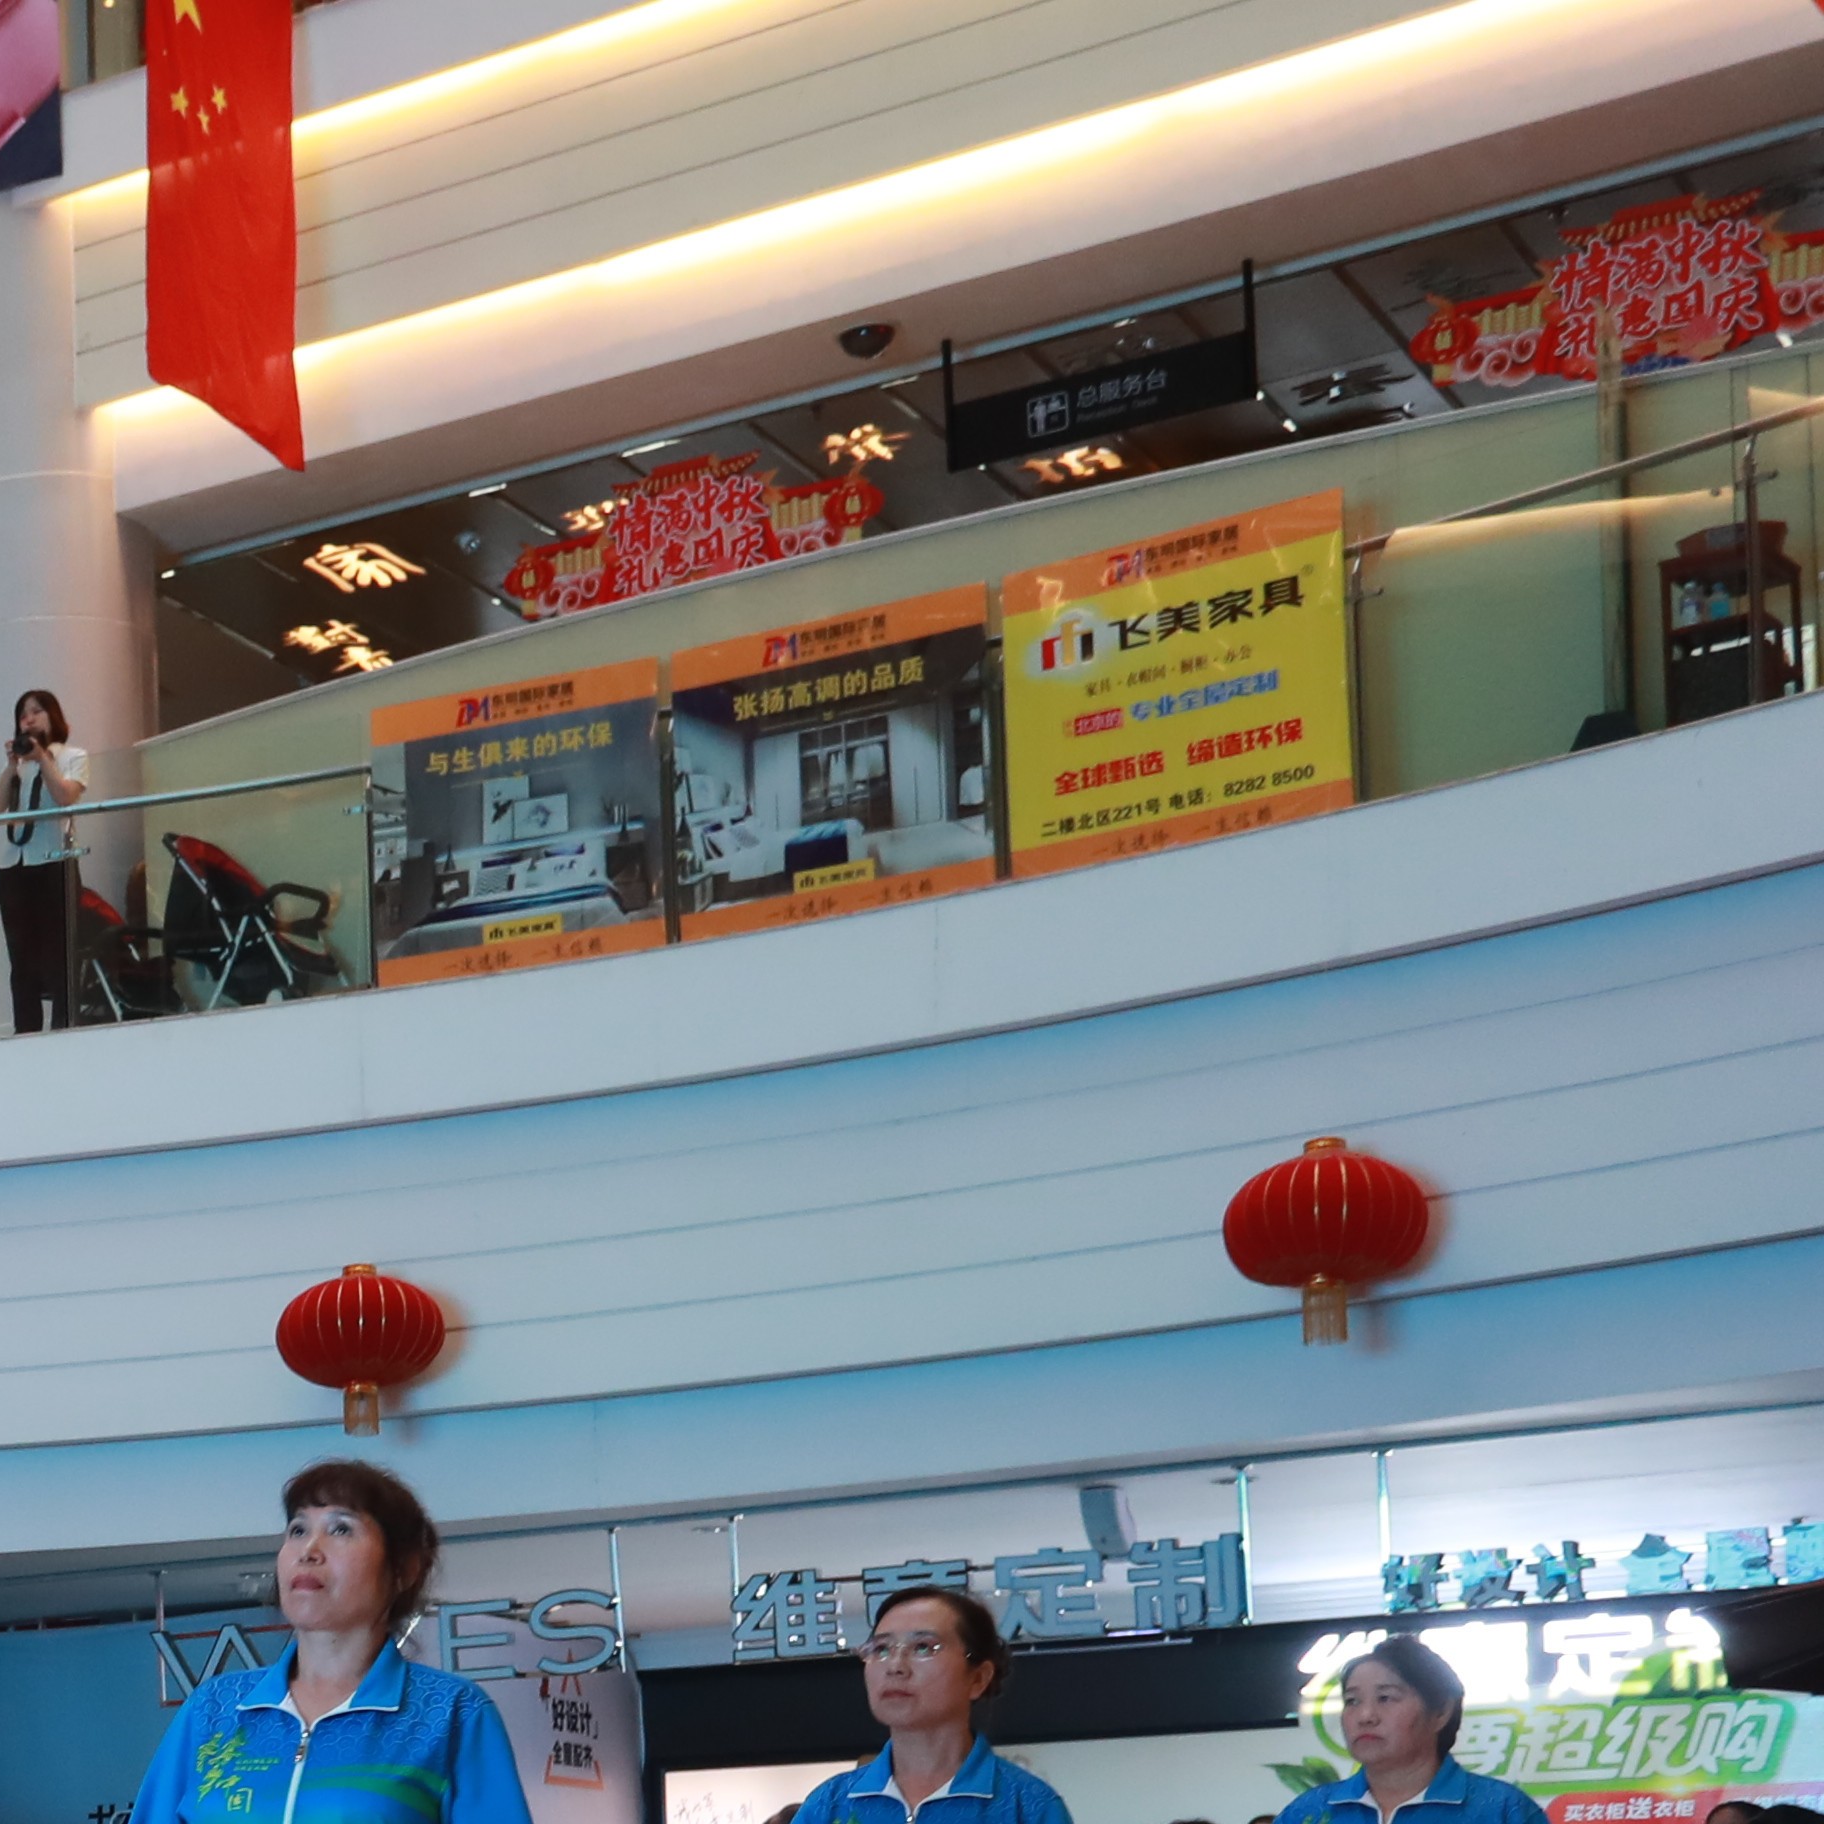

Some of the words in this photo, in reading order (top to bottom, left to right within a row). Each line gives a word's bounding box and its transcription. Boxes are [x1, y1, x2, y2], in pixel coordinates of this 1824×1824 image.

[1552, 218, 1768, 312] 情满中秋
[1077, 369, 1168, 408] 总服务台
[610, 475, 768, 553] 情满中秋
[1109, 576, 1306, 650] 飞美家具
[733, 656, 925, 721] 张扬高调的品质
[1131, 670, 1279, 721] 专业全屋定制
[426, 722, 613, 776] 与生俱来的环保
[1055, 750, 1164, 795] 全球甄选
[1187, 718, 1303, 766] 缔造环保
[1041, 799, 1161, 838] 二楼北区221号
[1223, 777, 1266, 799] 8282
[1271, 764, 1315, 787] 8500
[1563, 1794, 1695, 1821] 买衣柜送衣柜
